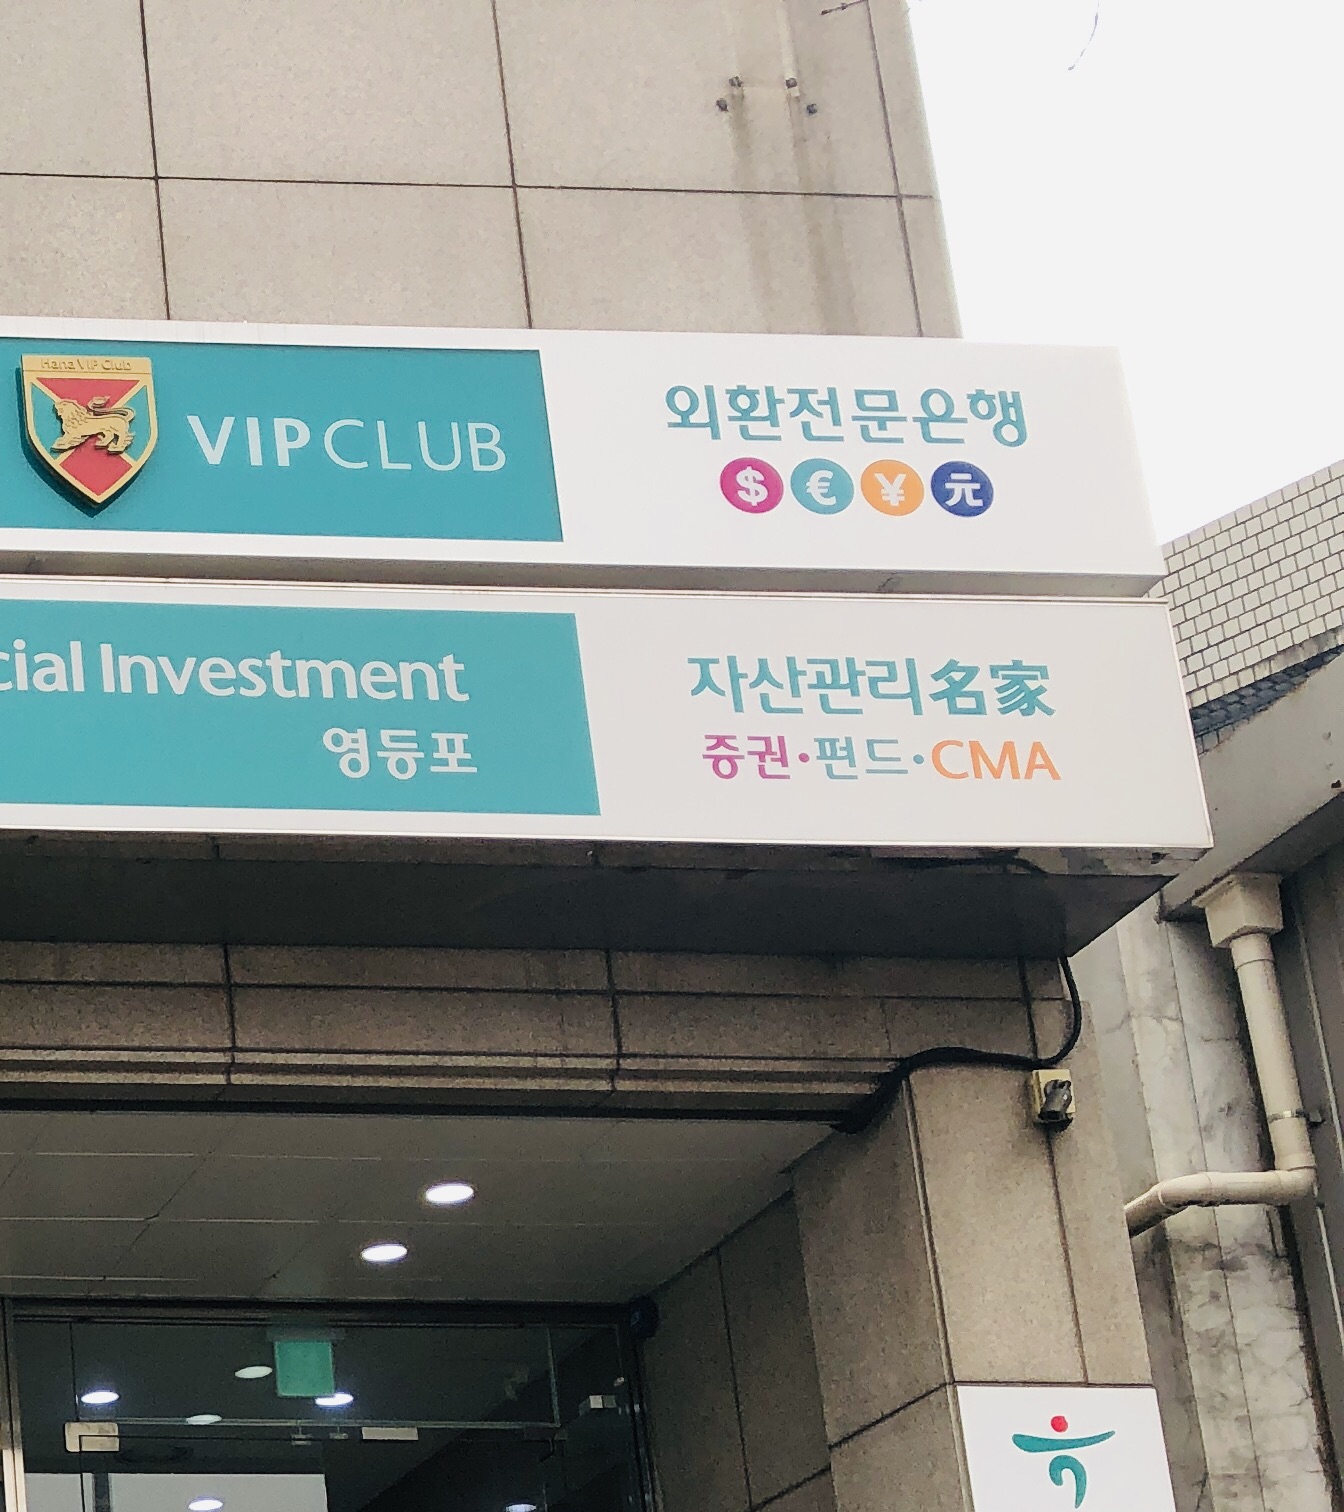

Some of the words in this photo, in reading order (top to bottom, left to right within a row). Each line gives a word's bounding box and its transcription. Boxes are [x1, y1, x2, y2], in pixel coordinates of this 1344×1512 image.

[41, 358, 74, 370] Hana
[101, 359, 132, 371] Club
[666, 385, 1027, 447] 외환전문은행
[100, 643, 471, 702] Investment
[322, 727, 478, 780] 영등포
